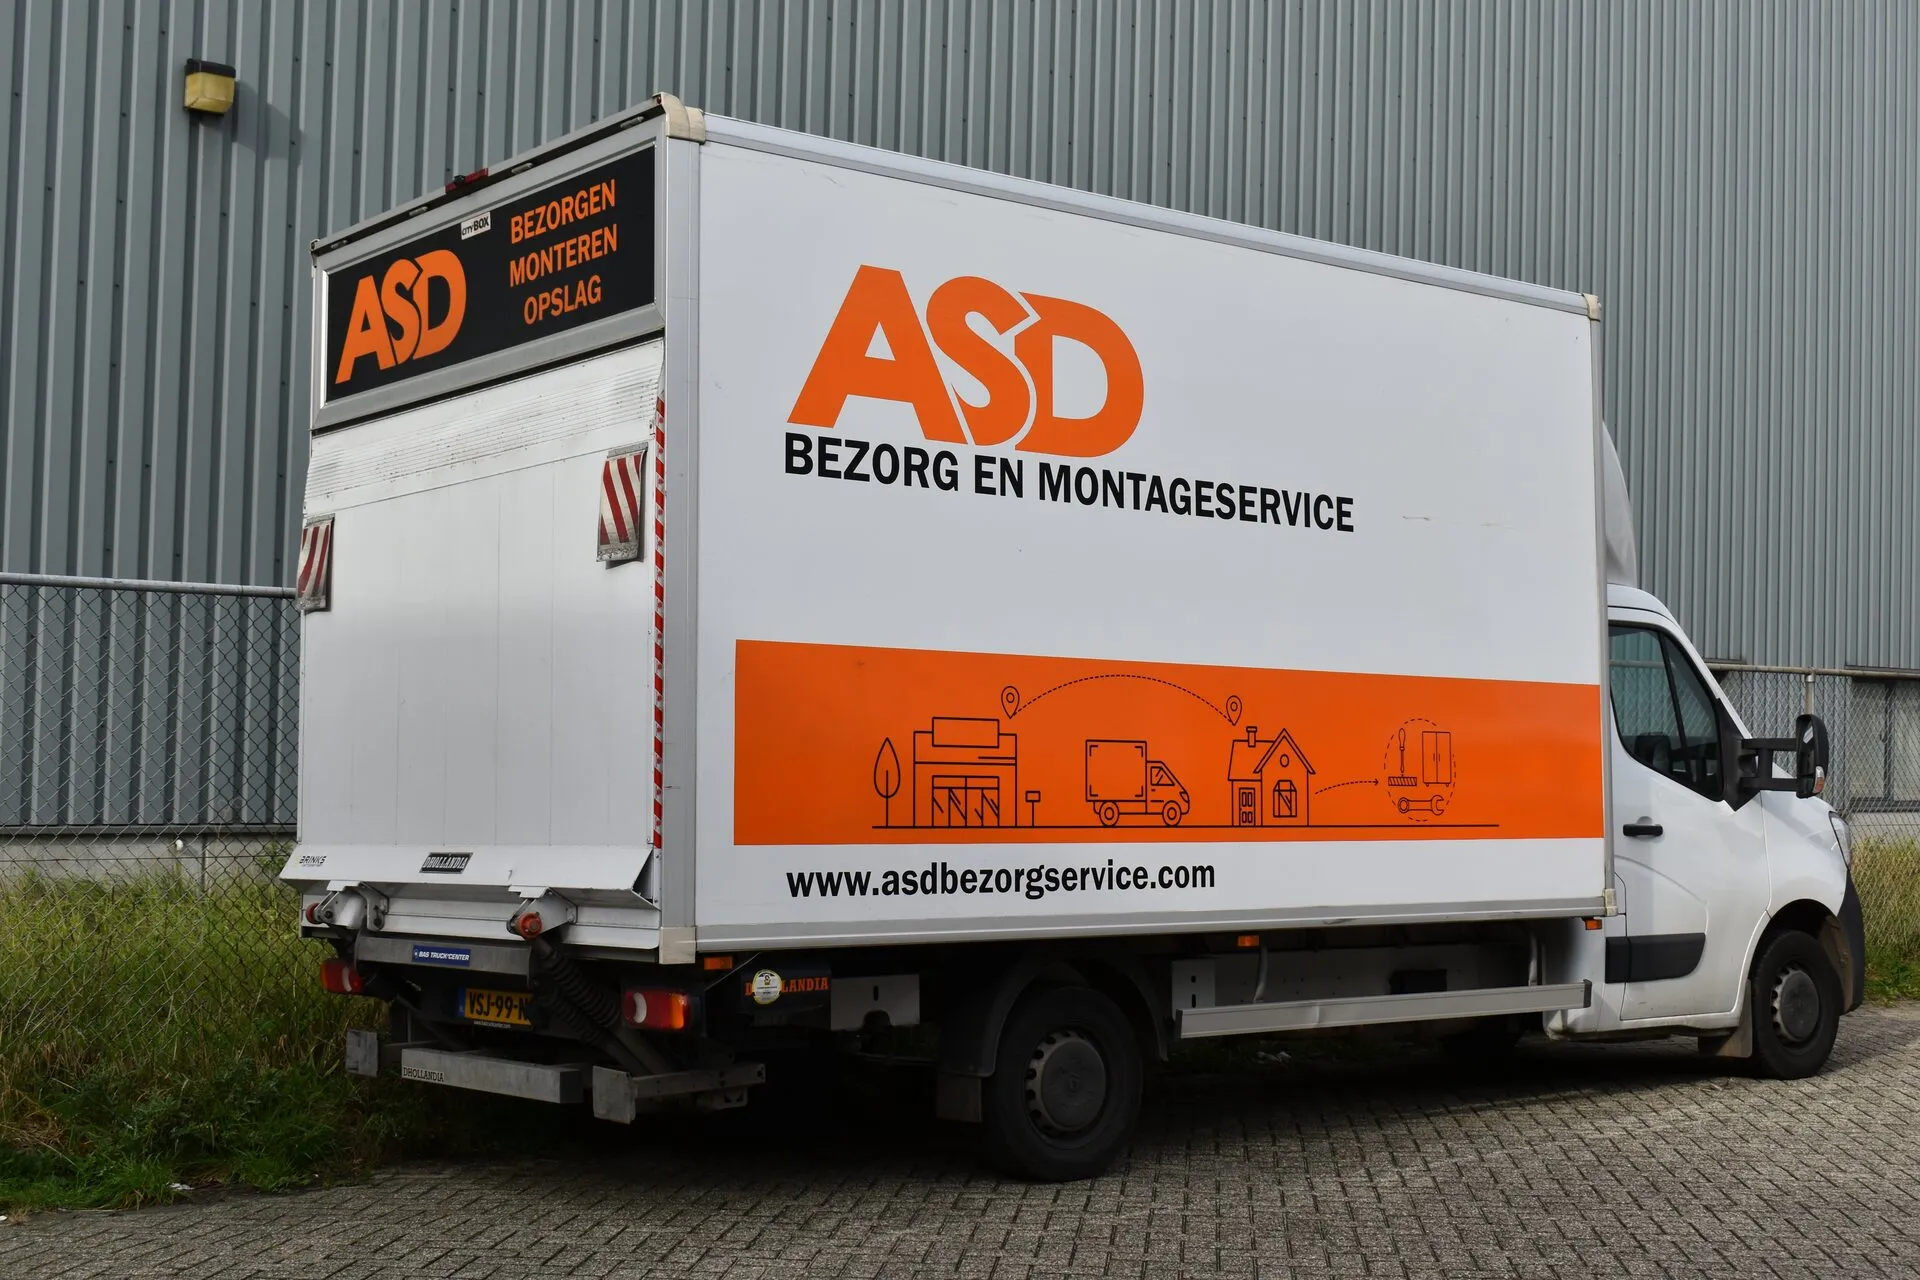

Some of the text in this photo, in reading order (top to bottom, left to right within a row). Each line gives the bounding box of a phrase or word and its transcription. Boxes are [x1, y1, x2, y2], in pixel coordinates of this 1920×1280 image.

[510, 178, 616, 245] BEZORGEN
[509, 224, 618, 287] MONTEREN
[335, 249, 467, 385] ASD
[523, 274, 602, 325] OPSLAG
[787, 264, 1144, 458] ASD
[785, 431, 1354, 533] BEZORG EN MONTAGESERVICE
[421, 855, 469, 869] DHOLLANDIA
[785, 858, 1215, 900] www.asdbezorgservice.com
[744, 976, 829, 996] DLANDIA
[403, 1066, 444, 1082] DHOLLANDIA
